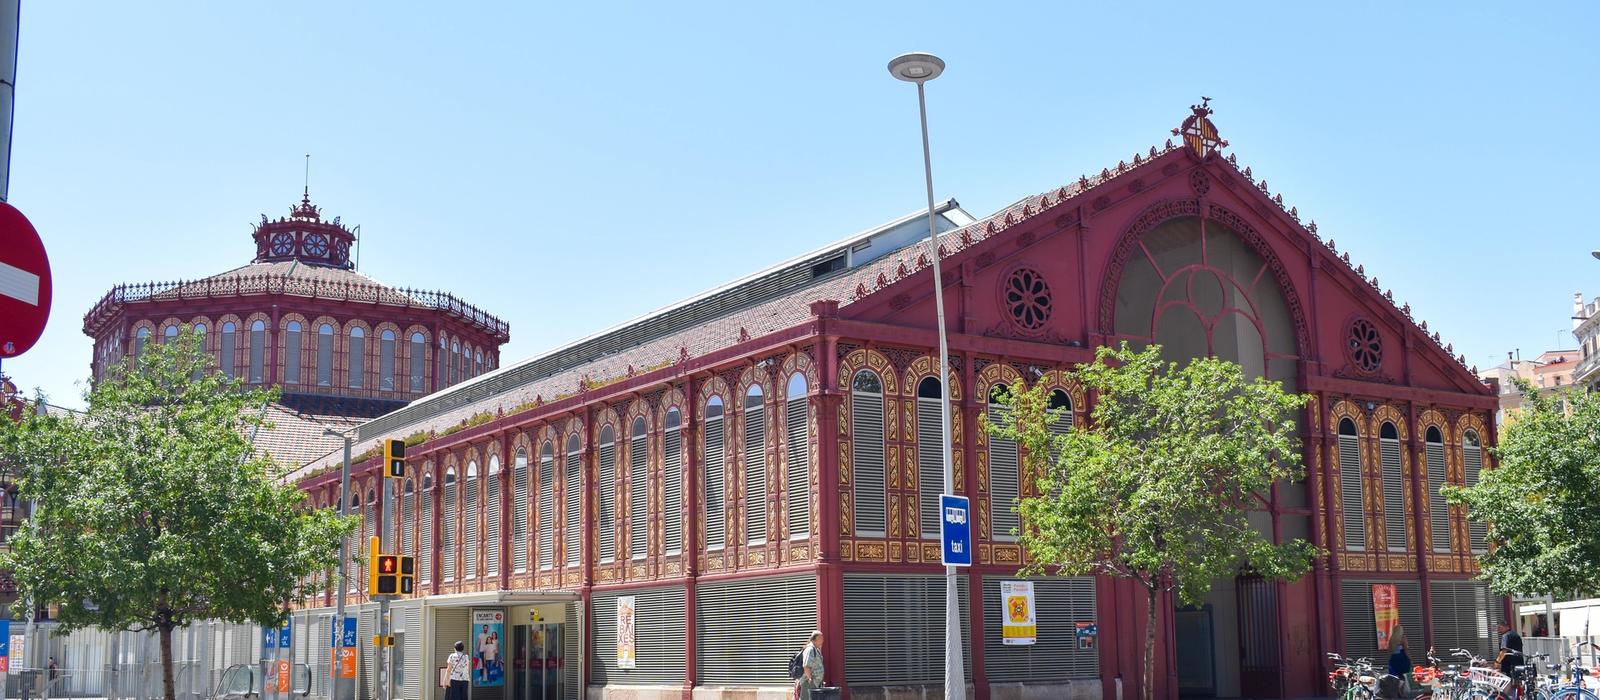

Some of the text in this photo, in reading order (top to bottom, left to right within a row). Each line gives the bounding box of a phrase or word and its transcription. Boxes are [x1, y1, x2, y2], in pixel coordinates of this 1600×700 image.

[951, 539, 963, 553] taxi
[620, 615, 632, 625] RE
[619, 624, 634, 634] BAI
[618, 633, 635, 644] XES
